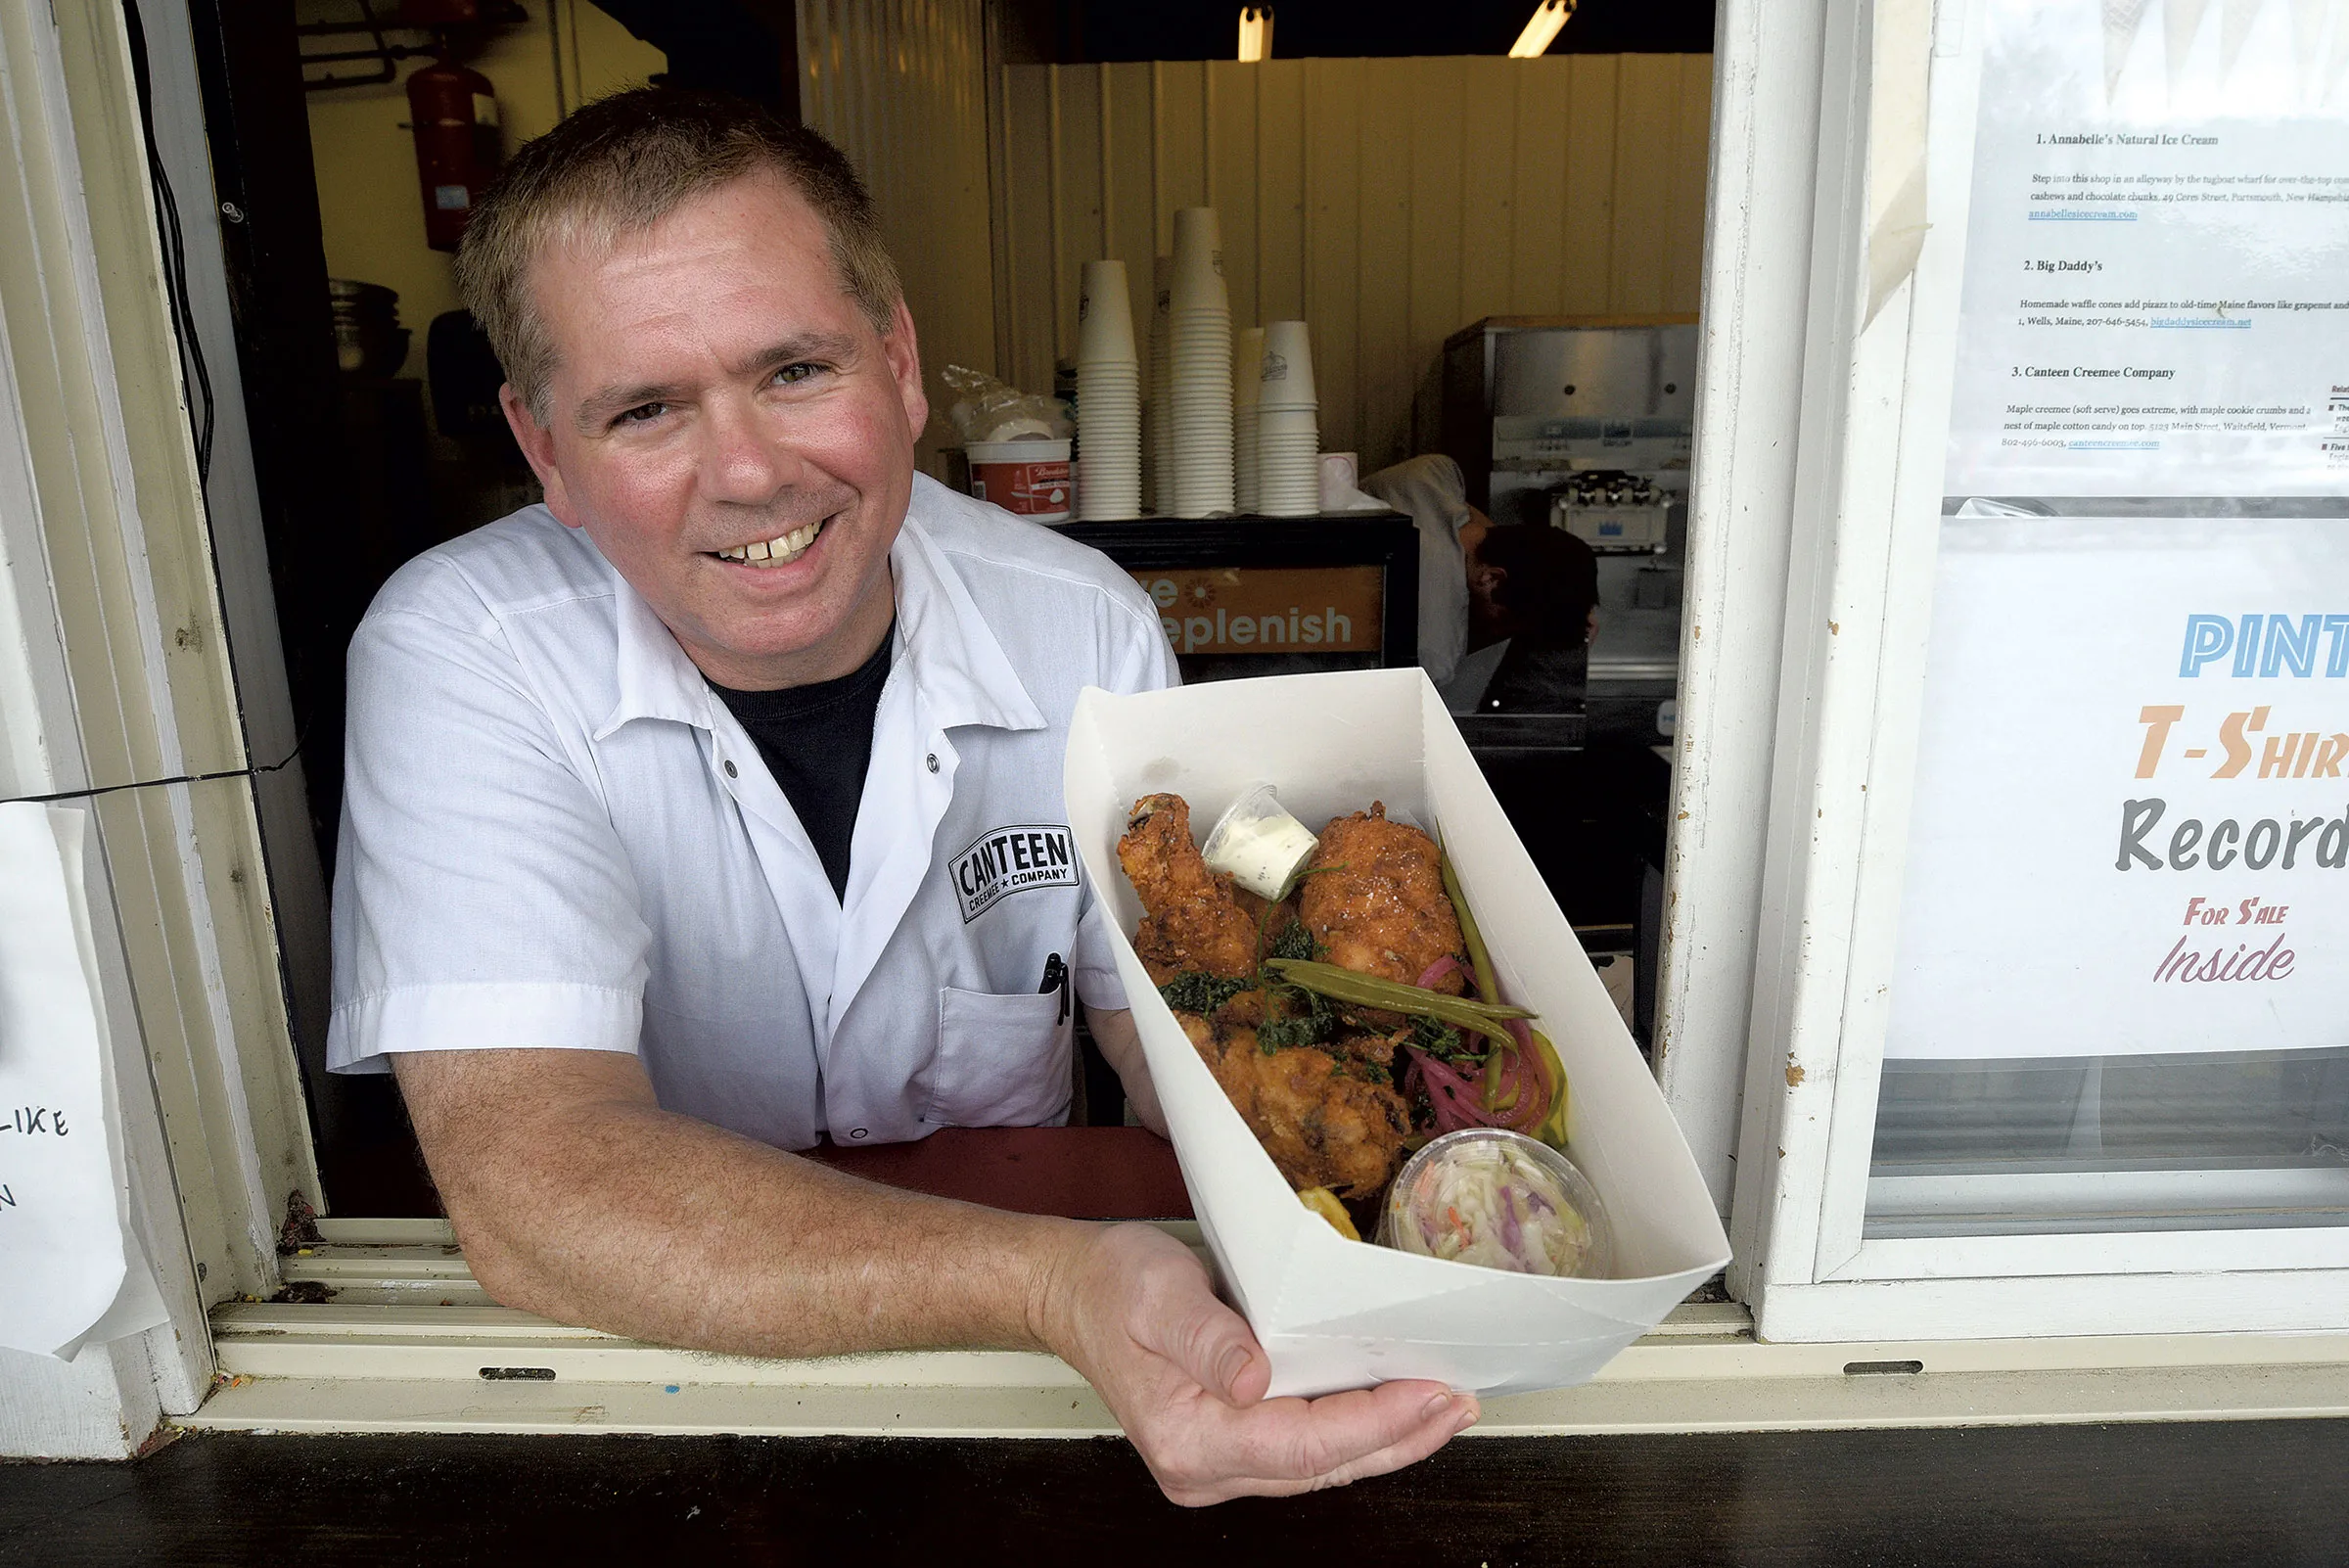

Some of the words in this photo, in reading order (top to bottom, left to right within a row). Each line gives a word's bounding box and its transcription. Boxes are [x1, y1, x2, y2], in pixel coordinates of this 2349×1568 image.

[2036, 133, 2047, 146] 1.
[2049, 133, 2113, 146] Annabelle's
[2117, 133, 2158, 146] Natural
[2162, 133, 2179, 146] Ice
[2183, 133, 2219, 146] Cream
[2032, 174, 2051, 184] Step
[2072, 174, 2089, 183] this
[2090, 174, 2111, 184] shop
[2113, 174, 2122, 183] in
[2137, 175, 2173, 185] alleyway
[2175, 174, 2185, 185] by
[2203, 175, 2235, 186] tugboat
[2237, 174, 2263, 184] wharf
[2263, 174, 2278, 184] for
[2030, 192, 2066, 201] cashews
[2067, 192, 2084, 201] and
[2086, 192, 2126, 201] chocolate
[2128, 192, 2161, 202] chunks,
[2201, 193, 2229, 203] Street,
[2232, 193, 2283, 203] Portsmouth,
[2285, 193, 2305, 202] New
[2028, 209, 2139, 221] annabellesicecream.com
[2023, 260, 2034, 271] 2.
[2037, 260, 2055, 273] Big
[2058, 260, 2103, 273] Daddy's
[2020, 300, 2069, 309] Homemade
[2071, 300, 2096, 309] waffle
[2124, 300, 2141, 309] add
[2170, 300, 2179, 309] to
[2180, 300, 2217, 309] old-time
[2219, 300, 2245, 309] Maine
[2247, 300, 2275, 309] flavors
[2278, 300, 2292, 309] like
[2293, 300, 2331, 311] grapenut
[2027, 317, 2053, 327] Wells,
[2055, 317, 2085, 327] Maine,
[2087, 317, 2148, 327] 207-646-5454,
[2011, 366, 2022, 378] 3.
[2025, 366, 2070, 378] Canteen
[2073, 366, 2120, 378] Creemee
[2123, 366, 2175, 380] Company
[2006, 404, 2033, 415] Maple
[2035, 405, 2071, 414] creemee
[2072, 404, 2092, 415] (soft
[2094, 404, 2120, 415] serve)
[2121, 407, 2140, 416] goes
[2142, 406, 2178, 415] extreme,
[2180, 405, 2198, 414] with
[2200, 405, 2226, 416] maple
[2227, 405, 2254, 415] cookie
[2256, 405, 2286, 415] crumbs
[2288, 405, 2305, 415] and
[2024, 421, 2034, 430] of
[2035, 421, 2061, 432] maple
[2062, 422, 2090, 431] cotton
[2092, 421, 2116, 432] candy
[2223, 422, 2267, 432] Waitsfield,
[2002, 438, 2067, 448] 802-496-6003,
[959, 833, 1069, 897] CANTEEN
[969, 882, 1000, 911] CREEMEE
[1011, 868, 1068, 886] COMPANY
[2153, 932, 2295, 983] Inside
